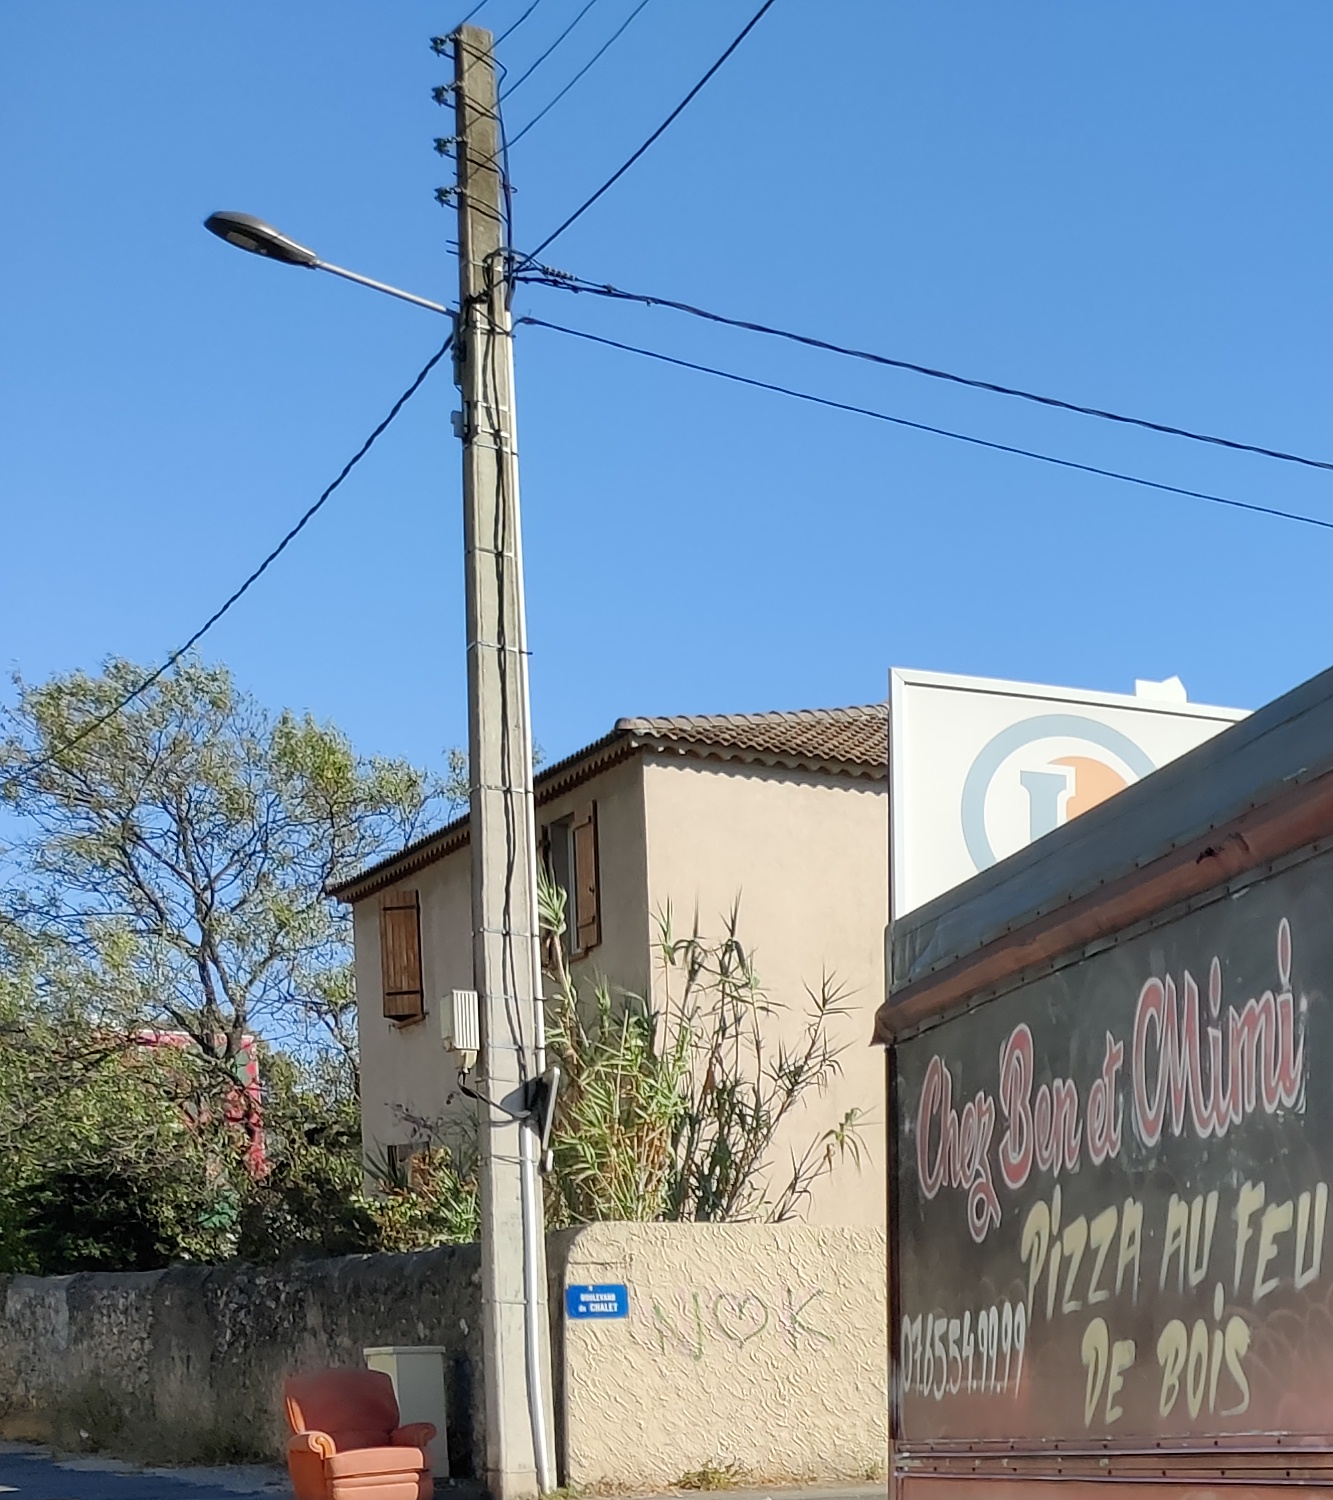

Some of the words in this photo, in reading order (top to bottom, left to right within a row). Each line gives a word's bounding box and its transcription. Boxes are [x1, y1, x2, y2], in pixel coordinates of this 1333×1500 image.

[916, 1055, 1000, 1243] Chez
[1000, 1022, 1082, 1190] Ben
[1087, 1030, 1124, 1165] et
[1132, 917, 1306, 1147] Mimi
[1159, 1191, 1219, 1293] AU
[1234, 1180, 1328, 1304] FEU
[590, 1302, 618, 1312] CHALET
